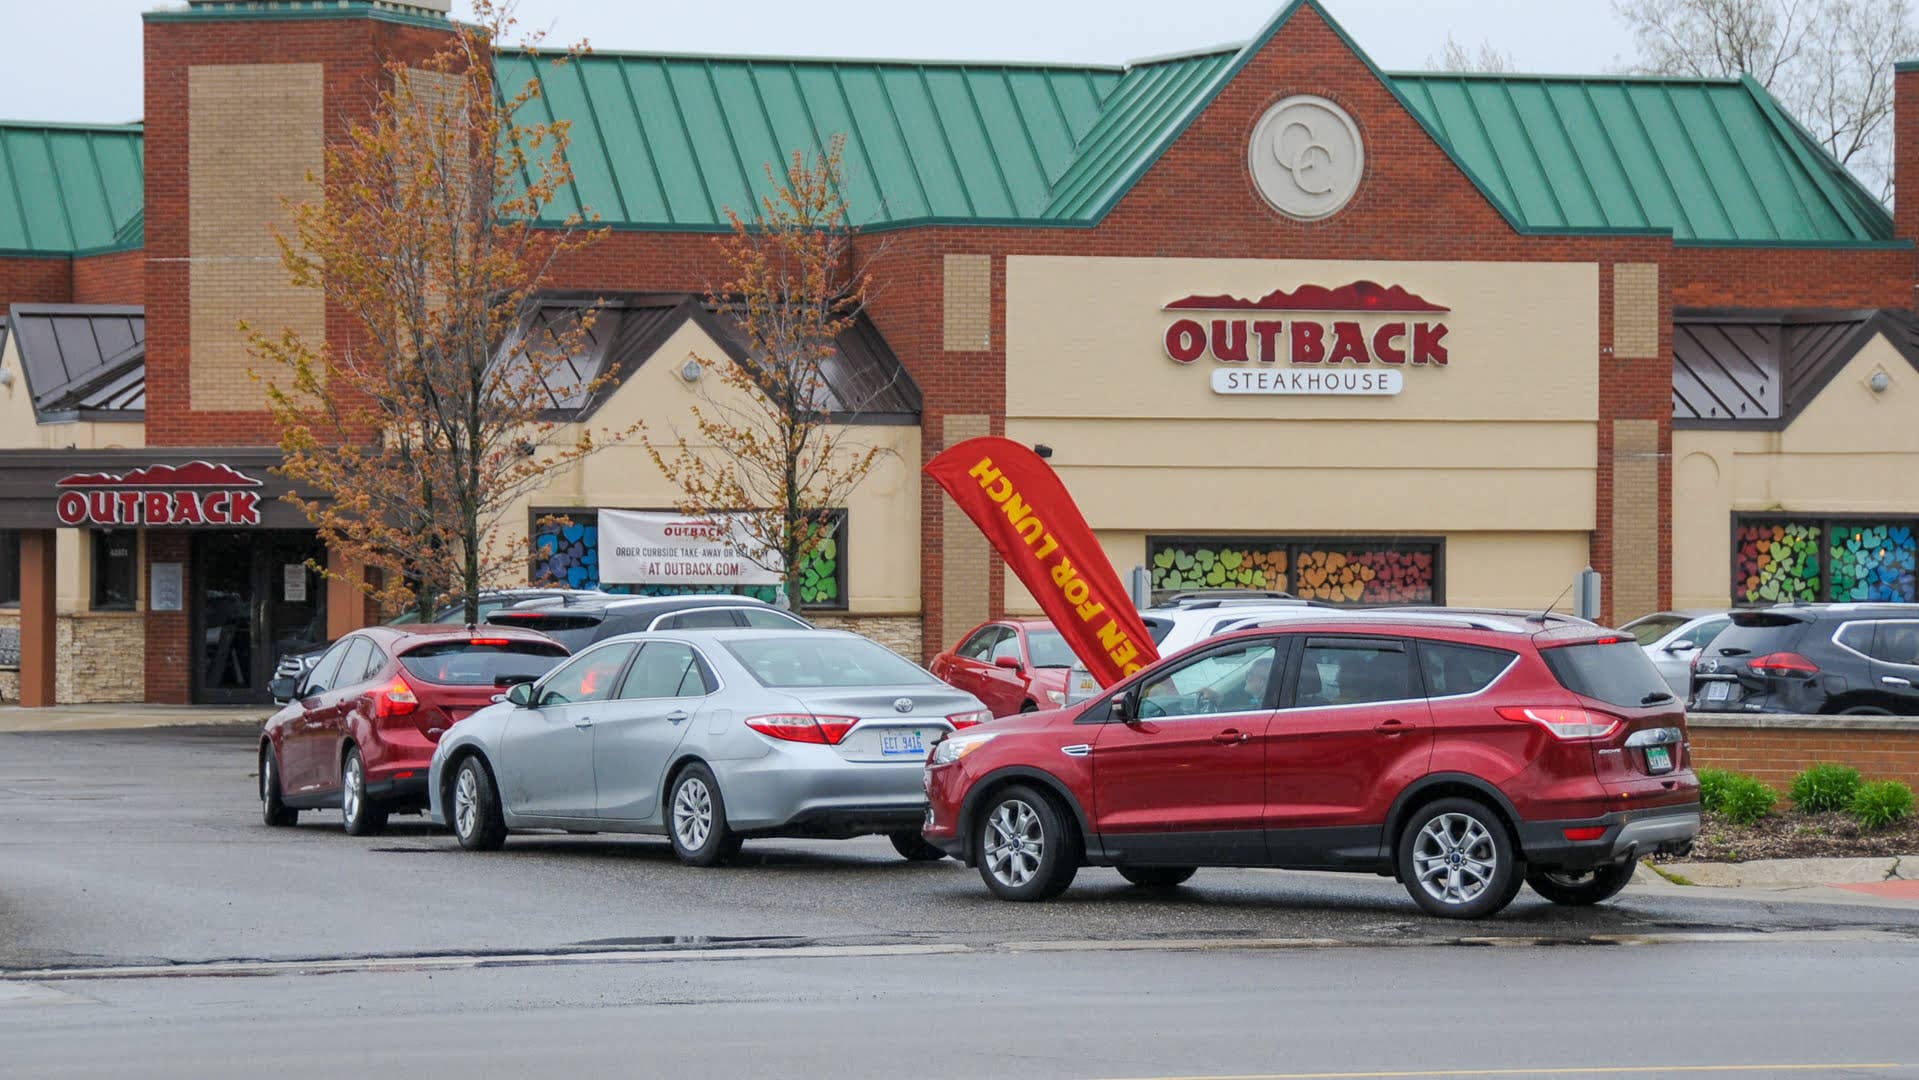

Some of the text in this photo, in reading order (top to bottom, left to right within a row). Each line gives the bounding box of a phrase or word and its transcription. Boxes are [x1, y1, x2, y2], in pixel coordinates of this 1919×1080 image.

[1164, 317, 1450, 366] OUTBACK
[1228, 372, 1388, 390] STEAKHOUSE
[57, 490, 261, 525] OUTBACK
[664, 527, 724, 537] OUTBACK
[616, 547, 640, 557] ORDER
[642, 547, 678, 557] CURBSIDE
[724, 548, 734, 557] OR
[648, 562, 739, 576] AT OUTBACK.COM
[969, 456, 1149, 678] PEN FOR LUNCH
[883, 736, 922, 749] ECT 9416
